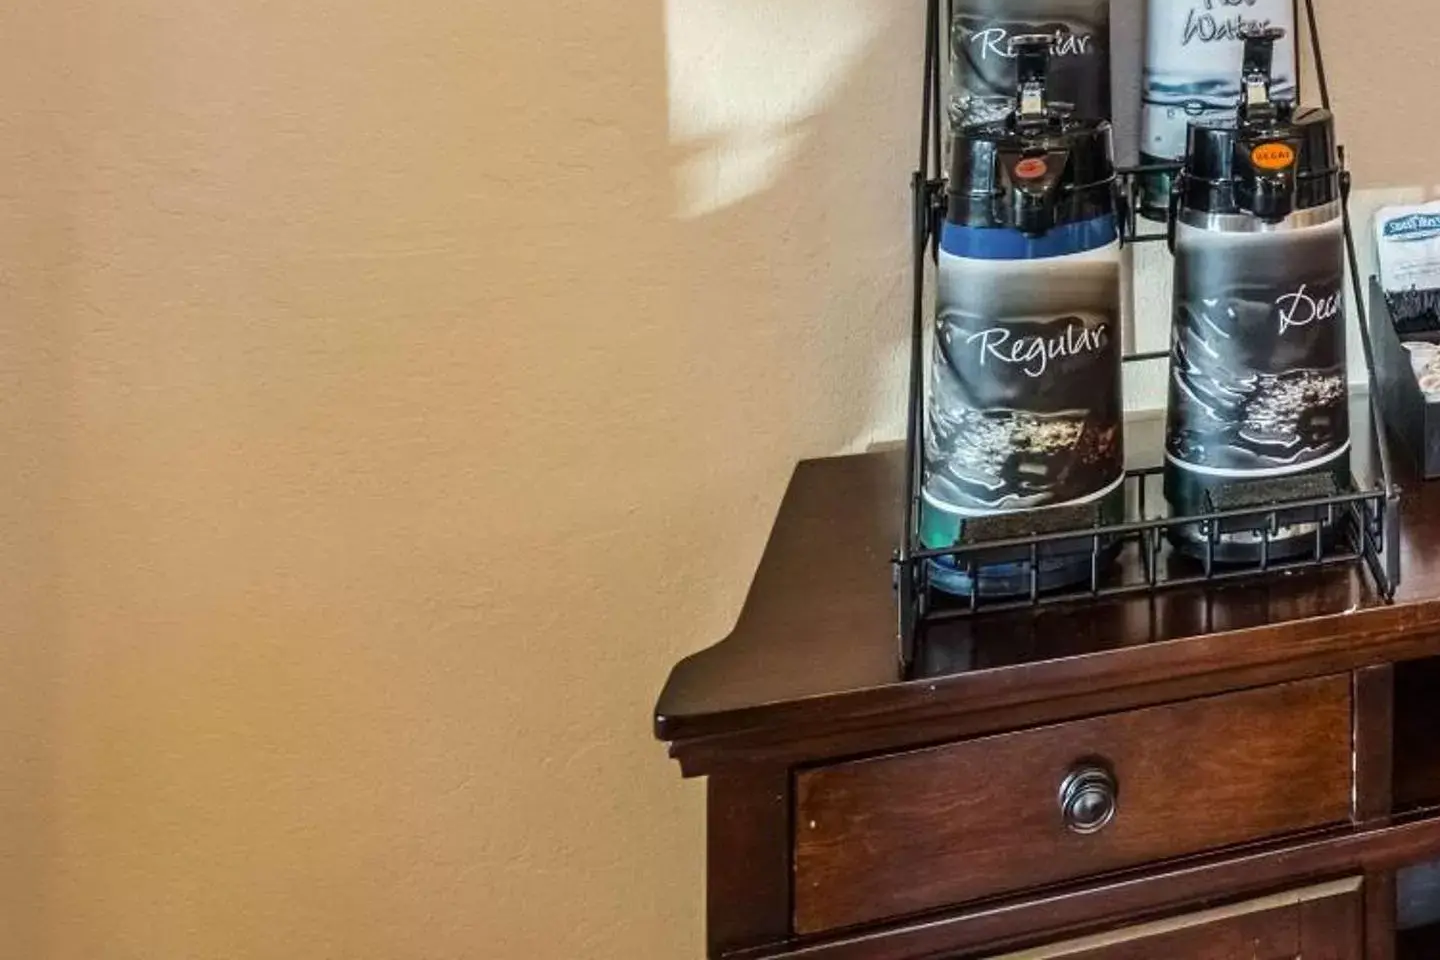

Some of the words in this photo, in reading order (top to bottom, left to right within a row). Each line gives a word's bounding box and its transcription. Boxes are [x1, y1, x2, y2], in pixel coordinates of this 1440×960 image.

[970, 27, 1089, 59] Relar
[1275, 283, 1341, 336] Deca
[966, 323, 1105, 377] Regular
